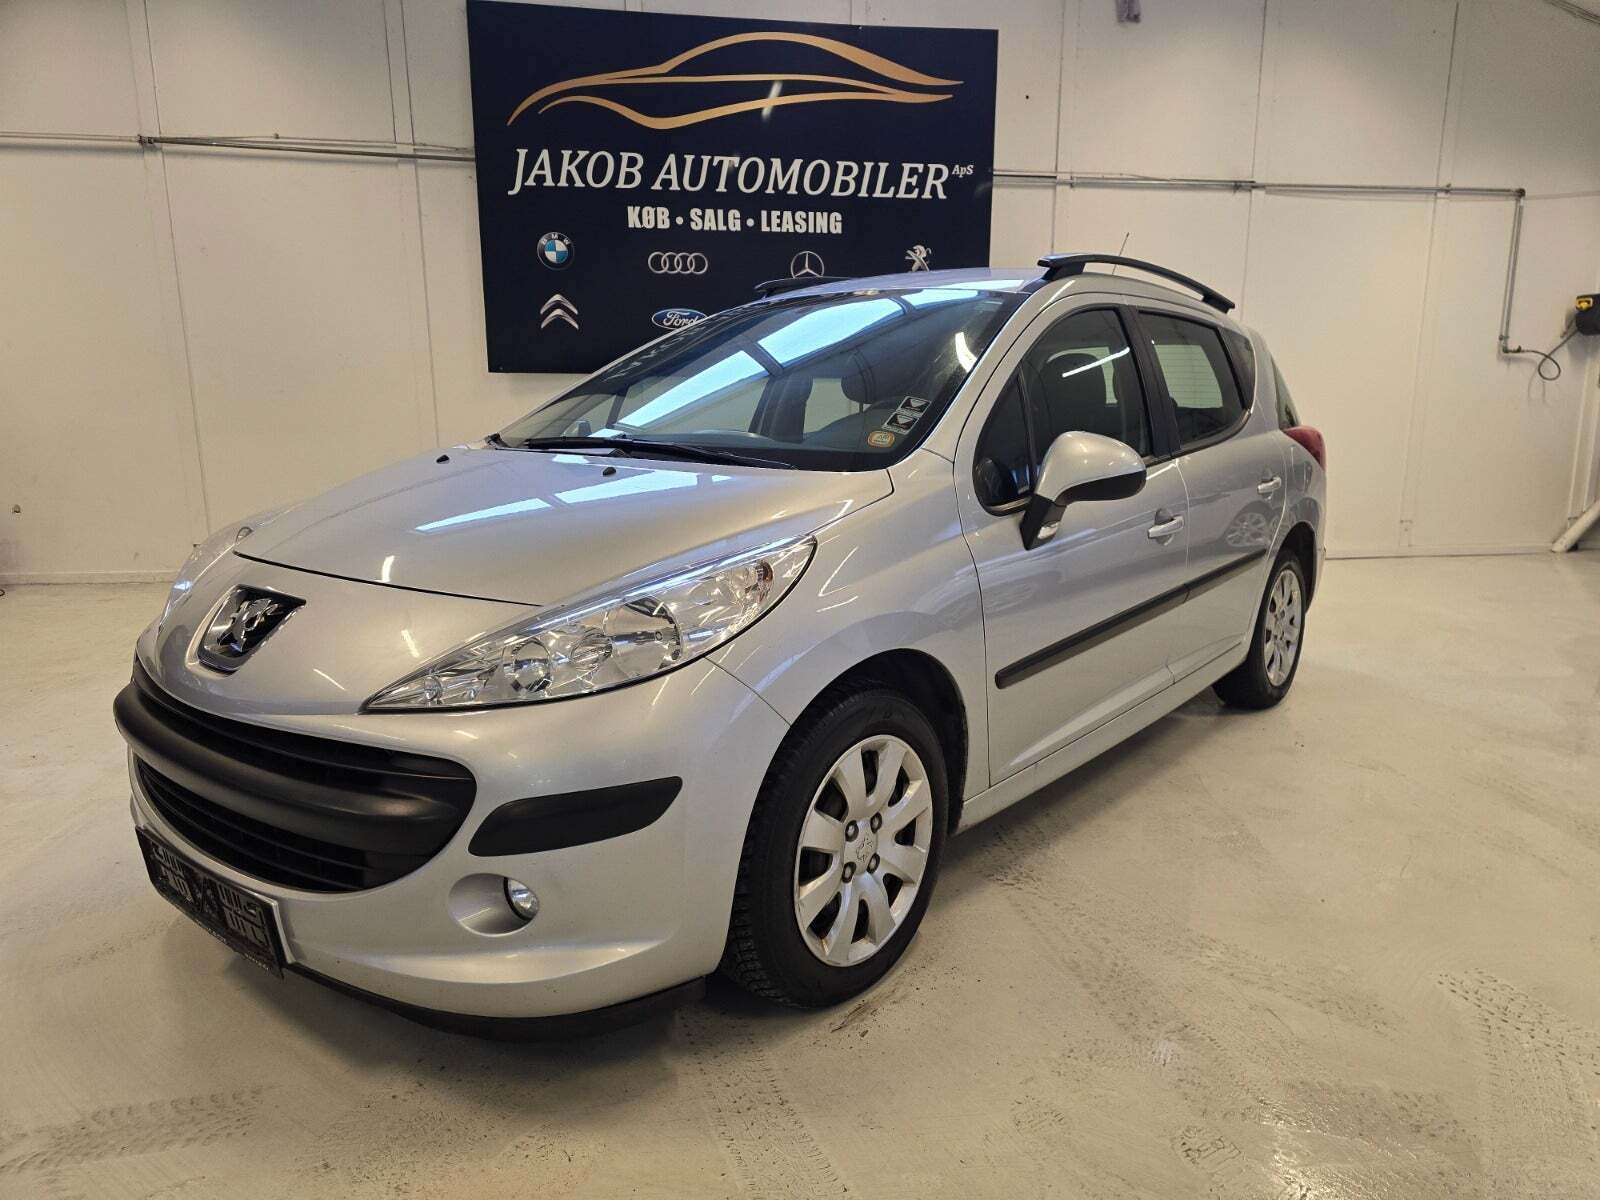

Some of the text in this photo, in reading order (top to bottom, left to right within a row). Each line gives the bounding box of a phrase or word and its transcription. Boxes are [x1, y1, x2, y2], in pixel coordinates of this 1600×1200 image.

[507, 148, 975, 199] JAKOB AUTOMOBILER ApS
[627, 206, 843, 234] KØB SALG LEASING
